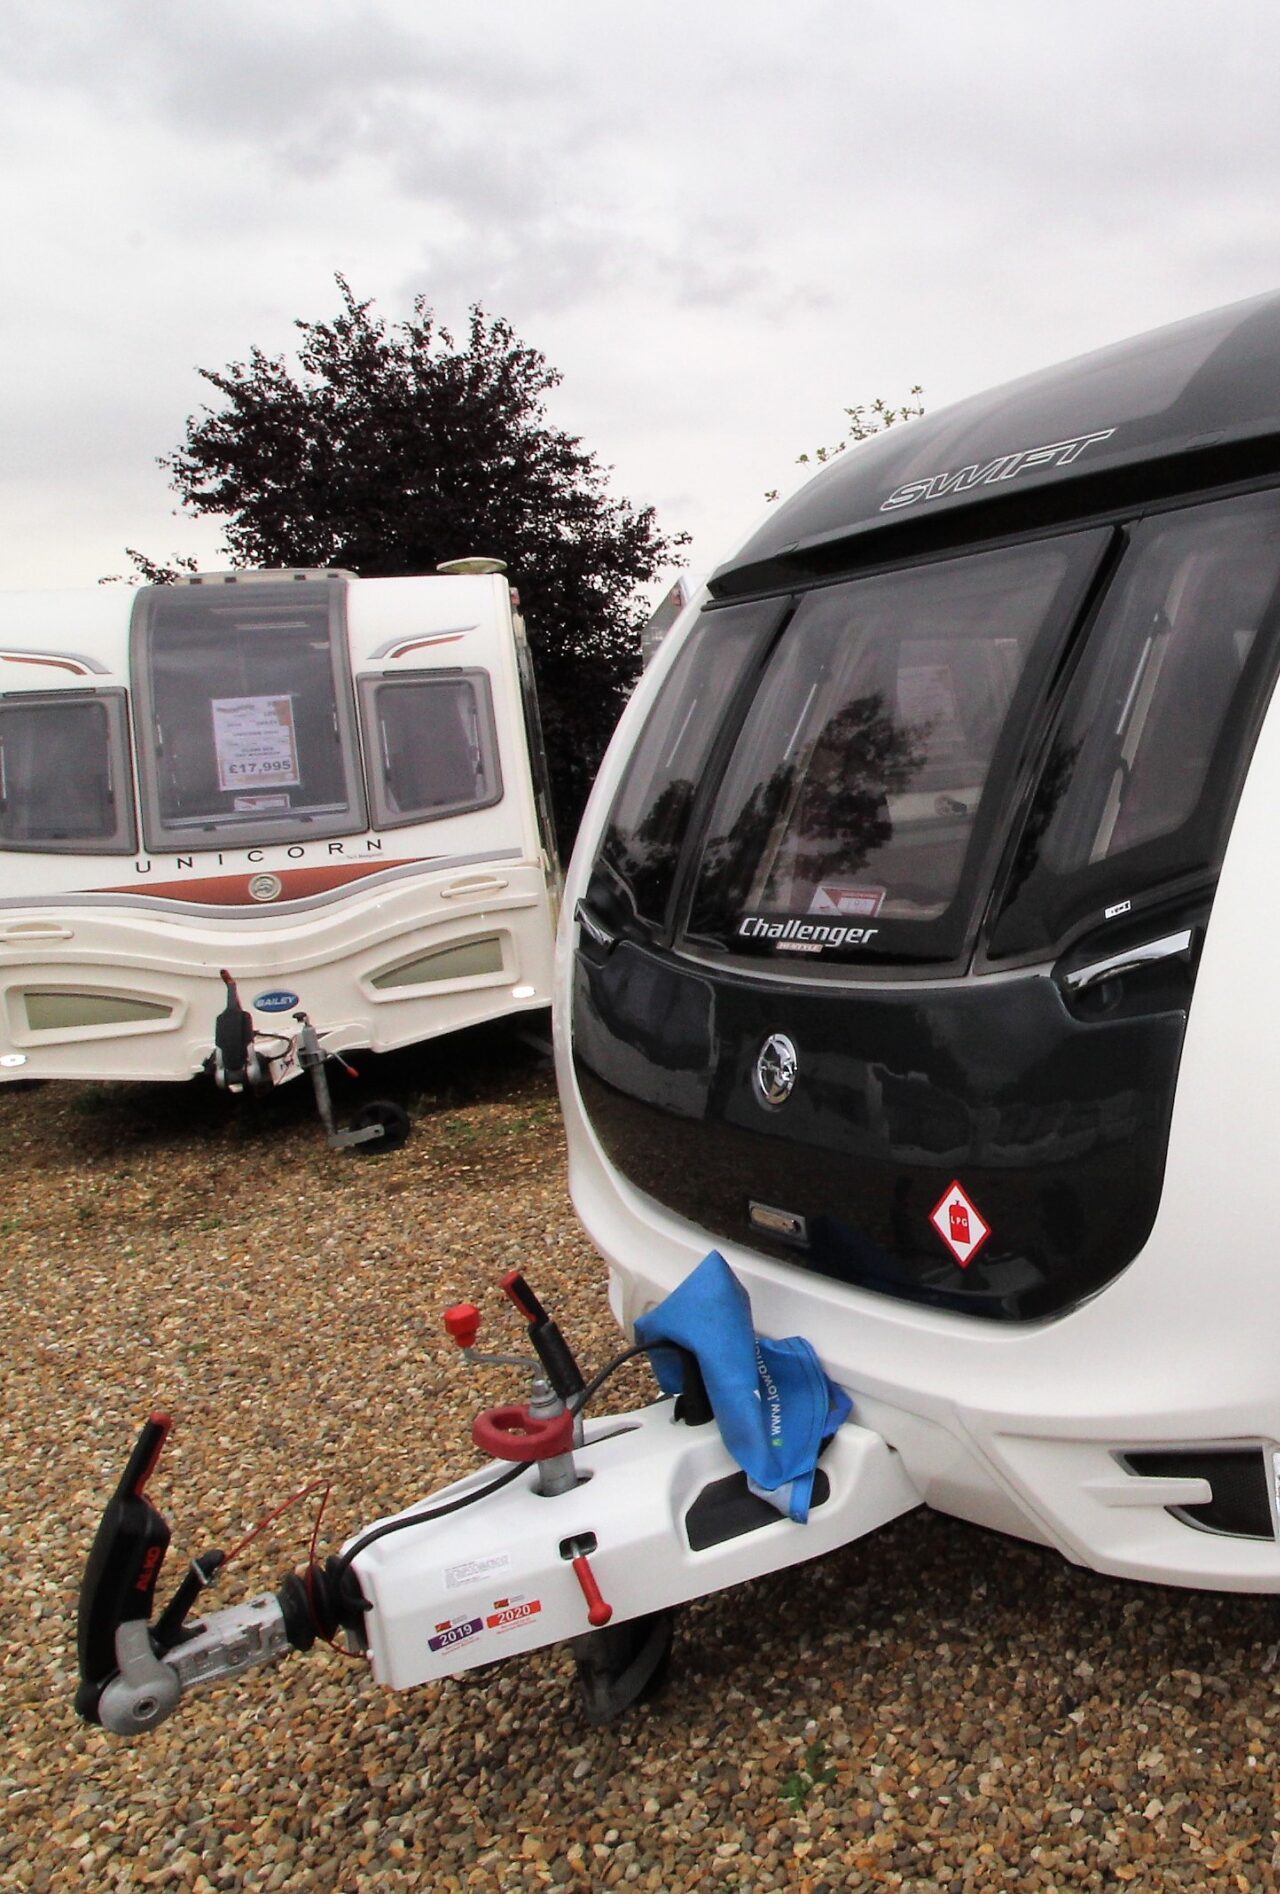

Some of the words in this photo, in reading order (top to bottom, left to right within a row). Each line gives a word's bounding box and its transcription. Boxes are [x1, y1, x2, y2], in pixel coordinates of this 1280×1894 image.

[880, 427, 1116, 511] SWIFT
[229, 760, 291, 774] £17,995
[135, 839, 382, 873] UNICORN
[739, 917, 879, 947] Challenger
[256, 996, 296, 1007] BAILEY
[951, 1216, 968, 1227] LPG
[498, 1605, 532, 1624] 2020
[439, 1623, 473, 1647] 2019
